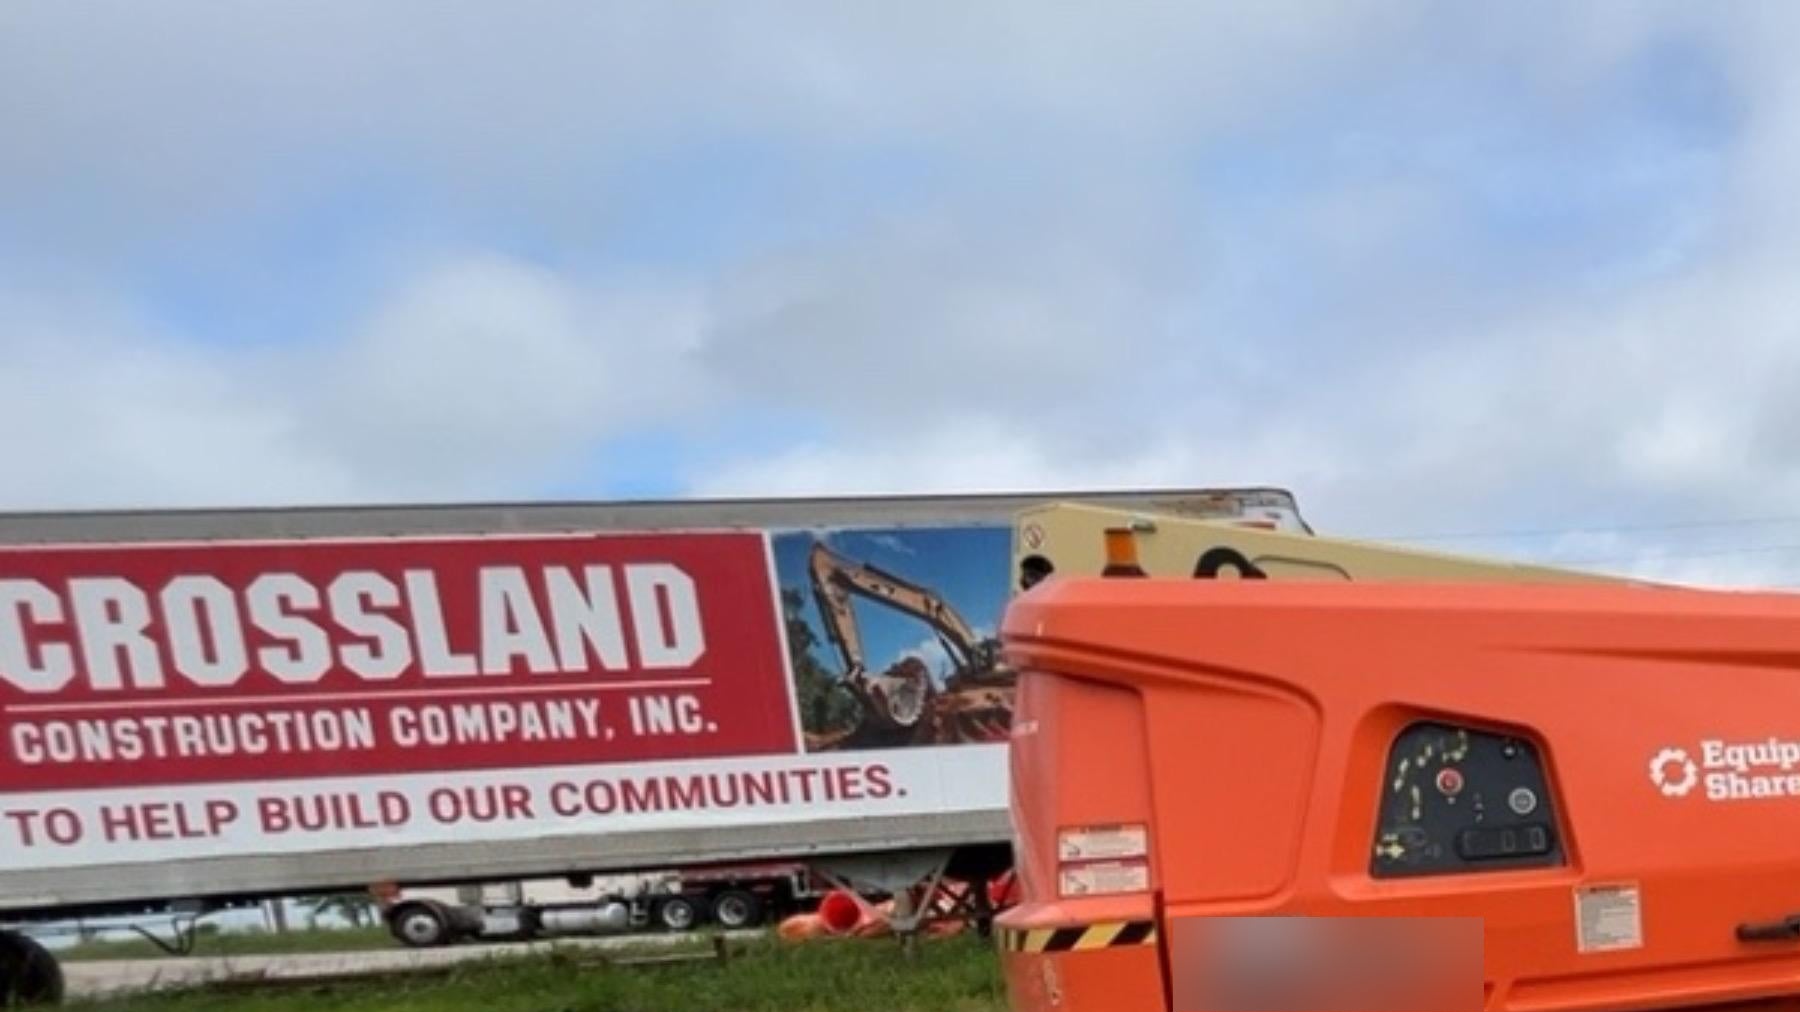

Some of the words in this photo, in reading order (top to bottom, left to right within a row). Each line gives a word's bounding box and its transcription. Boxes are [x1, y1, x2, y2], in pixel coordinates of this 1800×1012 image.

[0, 562, 706, 693] CROSSLAND
[10, 707, 376, 764] CONSTRUCTION
[389, 698, 614, 747] COMPANY,
[628, 694, 718, 736] INC.
[4, 807, 83, 847] TO
[100, 800, 238, 842] HELP
[257, 790, 410, 834] BUILD
[428, 784, 534, 824] OUR
[549, 764, 907, 817] COMMUNITIES.
